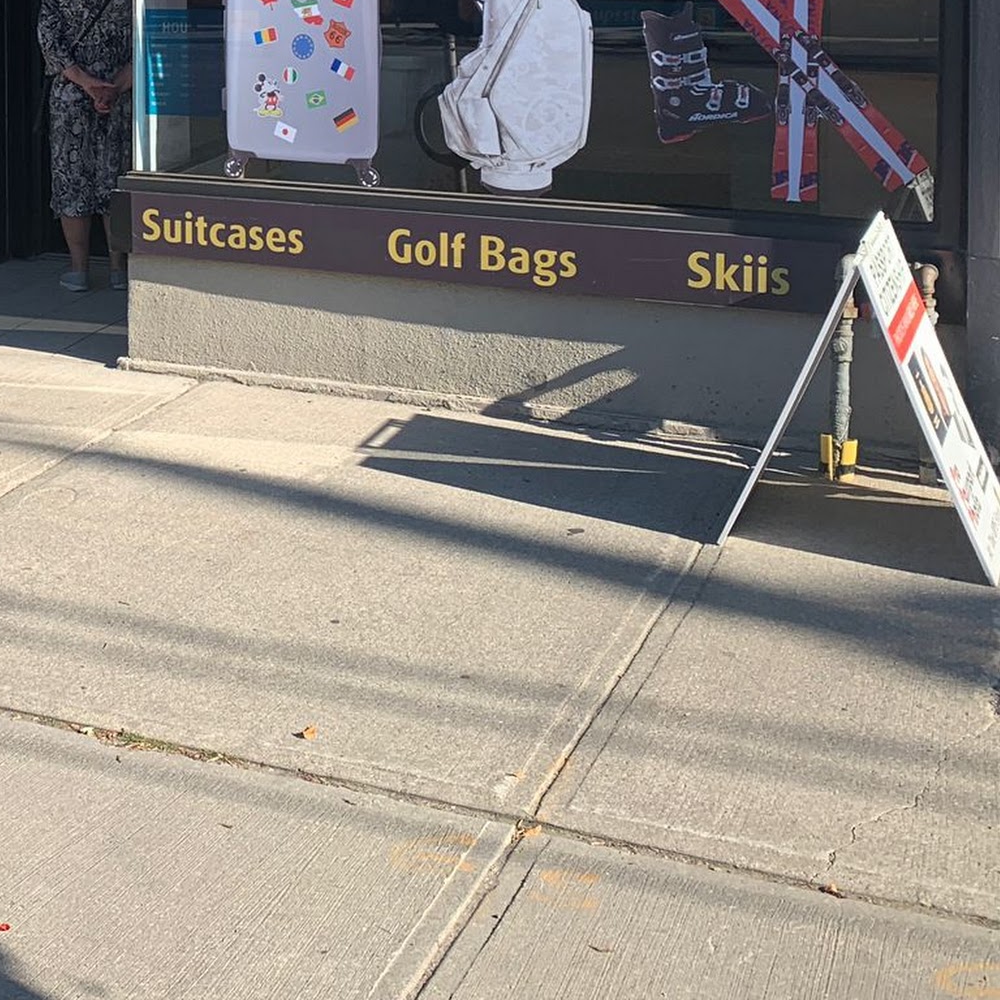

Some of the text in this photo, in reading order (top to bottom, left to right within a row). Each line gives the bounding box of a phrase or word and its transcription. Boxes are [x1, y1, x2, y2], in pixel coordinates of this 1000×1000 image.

[141, 207, 305, 255] Suitcases
[387, 227, 578, 287] Golf Bags
[686, 250, 791, 295] Skiis
